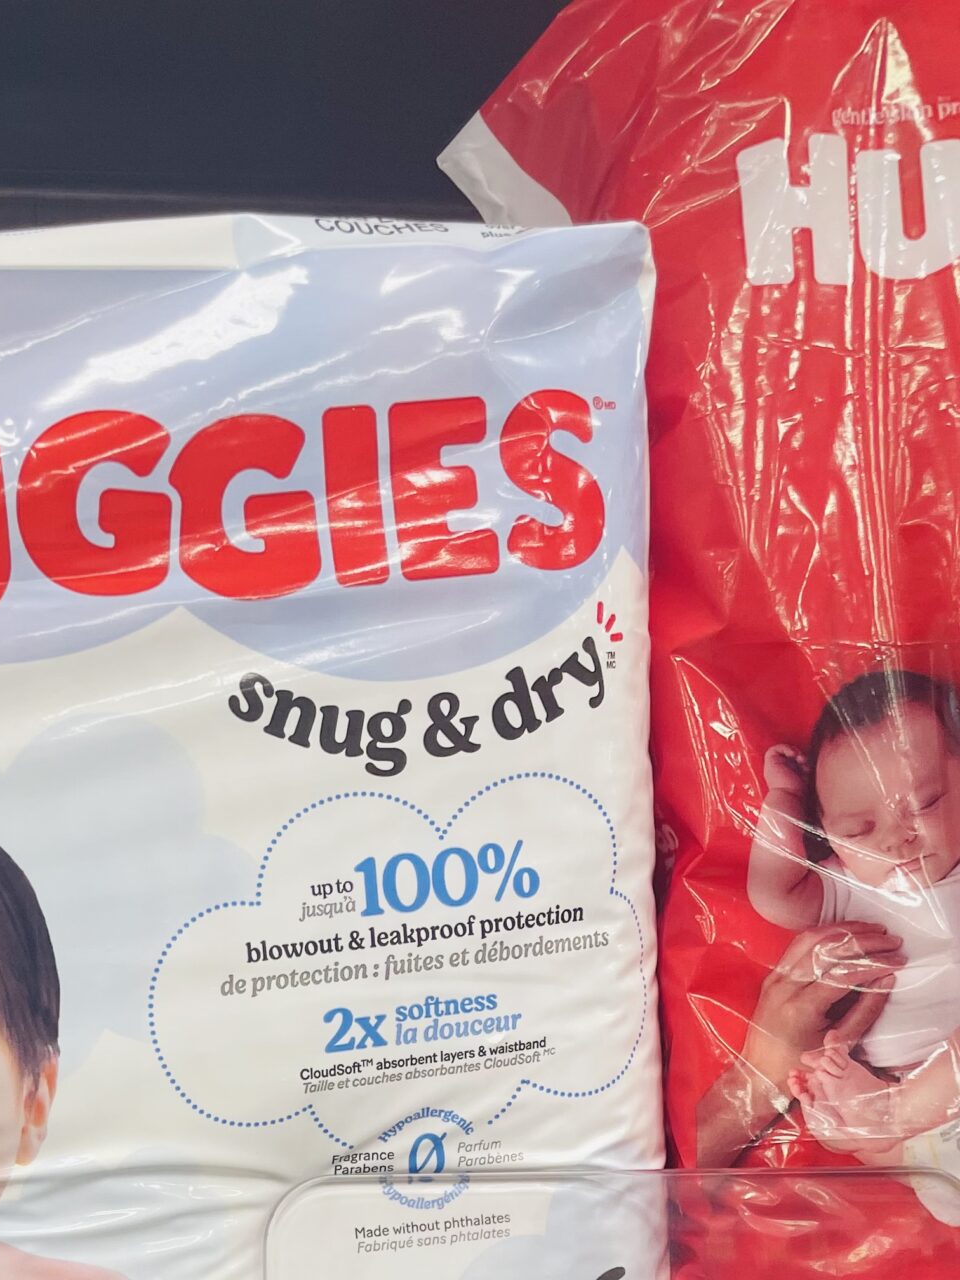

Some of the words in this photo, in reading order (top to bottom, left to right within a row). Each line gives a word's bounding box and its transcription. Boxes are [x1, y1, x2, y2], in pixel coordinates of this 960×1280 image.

[314, 217, 449, 237] COUCHES
[228, 672, 412, 777] snug
[423, 691, 481, 758] &
[492, 635, 607, 741] dry
[310, 881, 334, 899] up
[335, 878, 354, 895] to
[354, 839, 540, 917] 100%
[245, 933, 344, 964] blowout
[348, 931, 366, 950] &
[369, 916, 476, 949] leakproof
[479, 904, 584, 939] protection
[220, 973, 247, 998] de
[251, 959, 369, 996] protection
[383, 950, 445, 983] fuites
[449, 945, 470, 967] et
[473, 928, 610, 966] débordements
[323, 1006, 389, 1054] 2x
[394, 993, 499, 1024] softness
[395, 1020, 419, 1047] la
[423, 1008, 522, 1044] douceur
[375, 1051, 439, 1072] absorbent
[440, 1047, 476, 1066] layers
[478, 1045, 488, 1058] &
[489, 1036, 548, 1057] waistband
[302, 1080, 335, 1095] Taille
[337, 1078, 350, 1091] et
[351, 1072, 398, 1090] couches
[399, 1061, 481, 1084] absorbantes
[483, 1050, 542, 1072] CloudSoft
[377, 1106, 475, 1145] Hypoallergenic
[331, 1149, 395, 1166] Fragrance
[457, 1138, 502, 1154] Parfum
[457, 1150, 525, 1168] Parabènes
[334, 1163, 395, 1176] Parabens
[354, 1225, 390, 1241] Made
[393, 1219, 441, 1238] without
[443, 1212, 512, 1235] phthalates
[357, 1239, 414, 1256] Fabriqué
[417, 1236, 448, 1248] sans
[450, 1227, 512, 1248] phtalates
